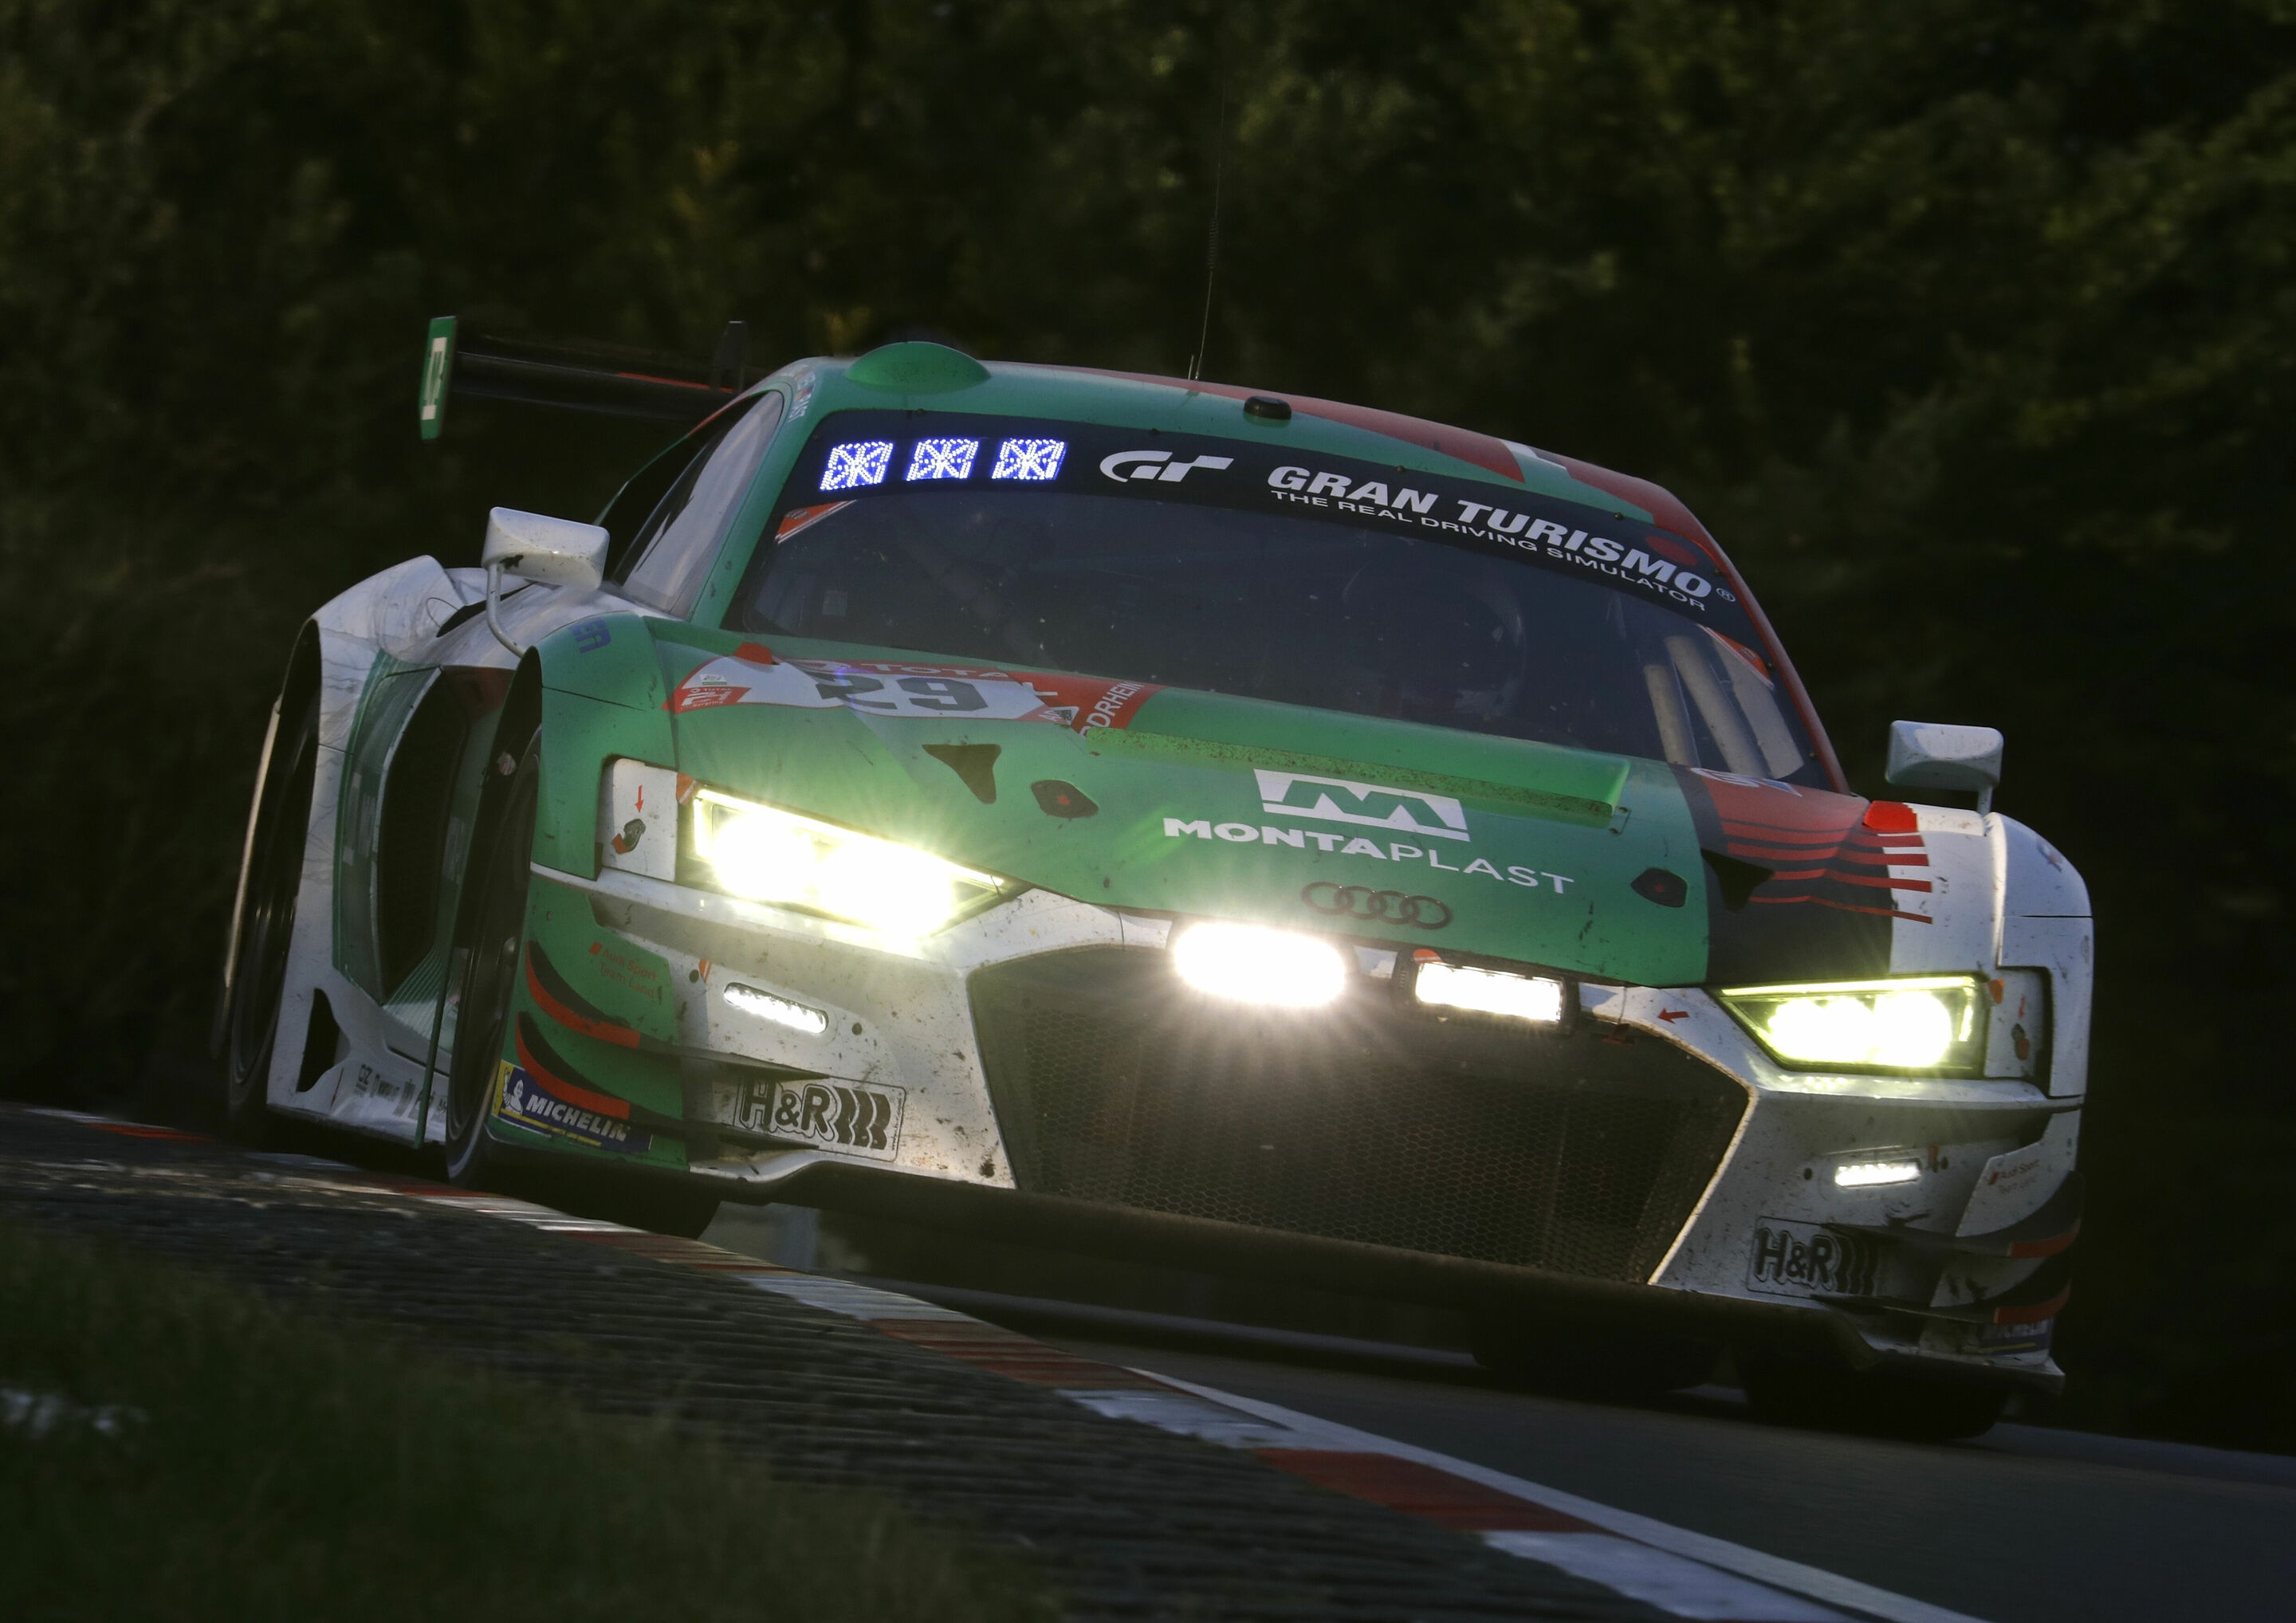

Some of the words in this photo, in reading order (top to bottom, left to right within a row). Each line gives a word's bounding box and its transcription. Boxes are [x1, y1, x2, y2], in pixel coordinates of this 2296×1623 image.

[1268, 466, 1438, 515] GRAN
[1271, 490, 1328, 507] THE
[1338, 501, 1413, 524] REAL
[1421, 517, 1539, 552] DRIVING
[1547, 546, 1706, 611] SIMULATOR
[804, 670, 989, 712] 29
[1163, 818, 1574, 894] MONTAPLAST
[600, 962, 626, 984] Team
[602, 948, 626, 967] Audi
[627, 960, 658, 983] Sport
[525, 1094, 627, 1142] MICHELIN
[741, 1079, 834, 1139] H&R
[1755, 1228, 1834, 1289] H&R
